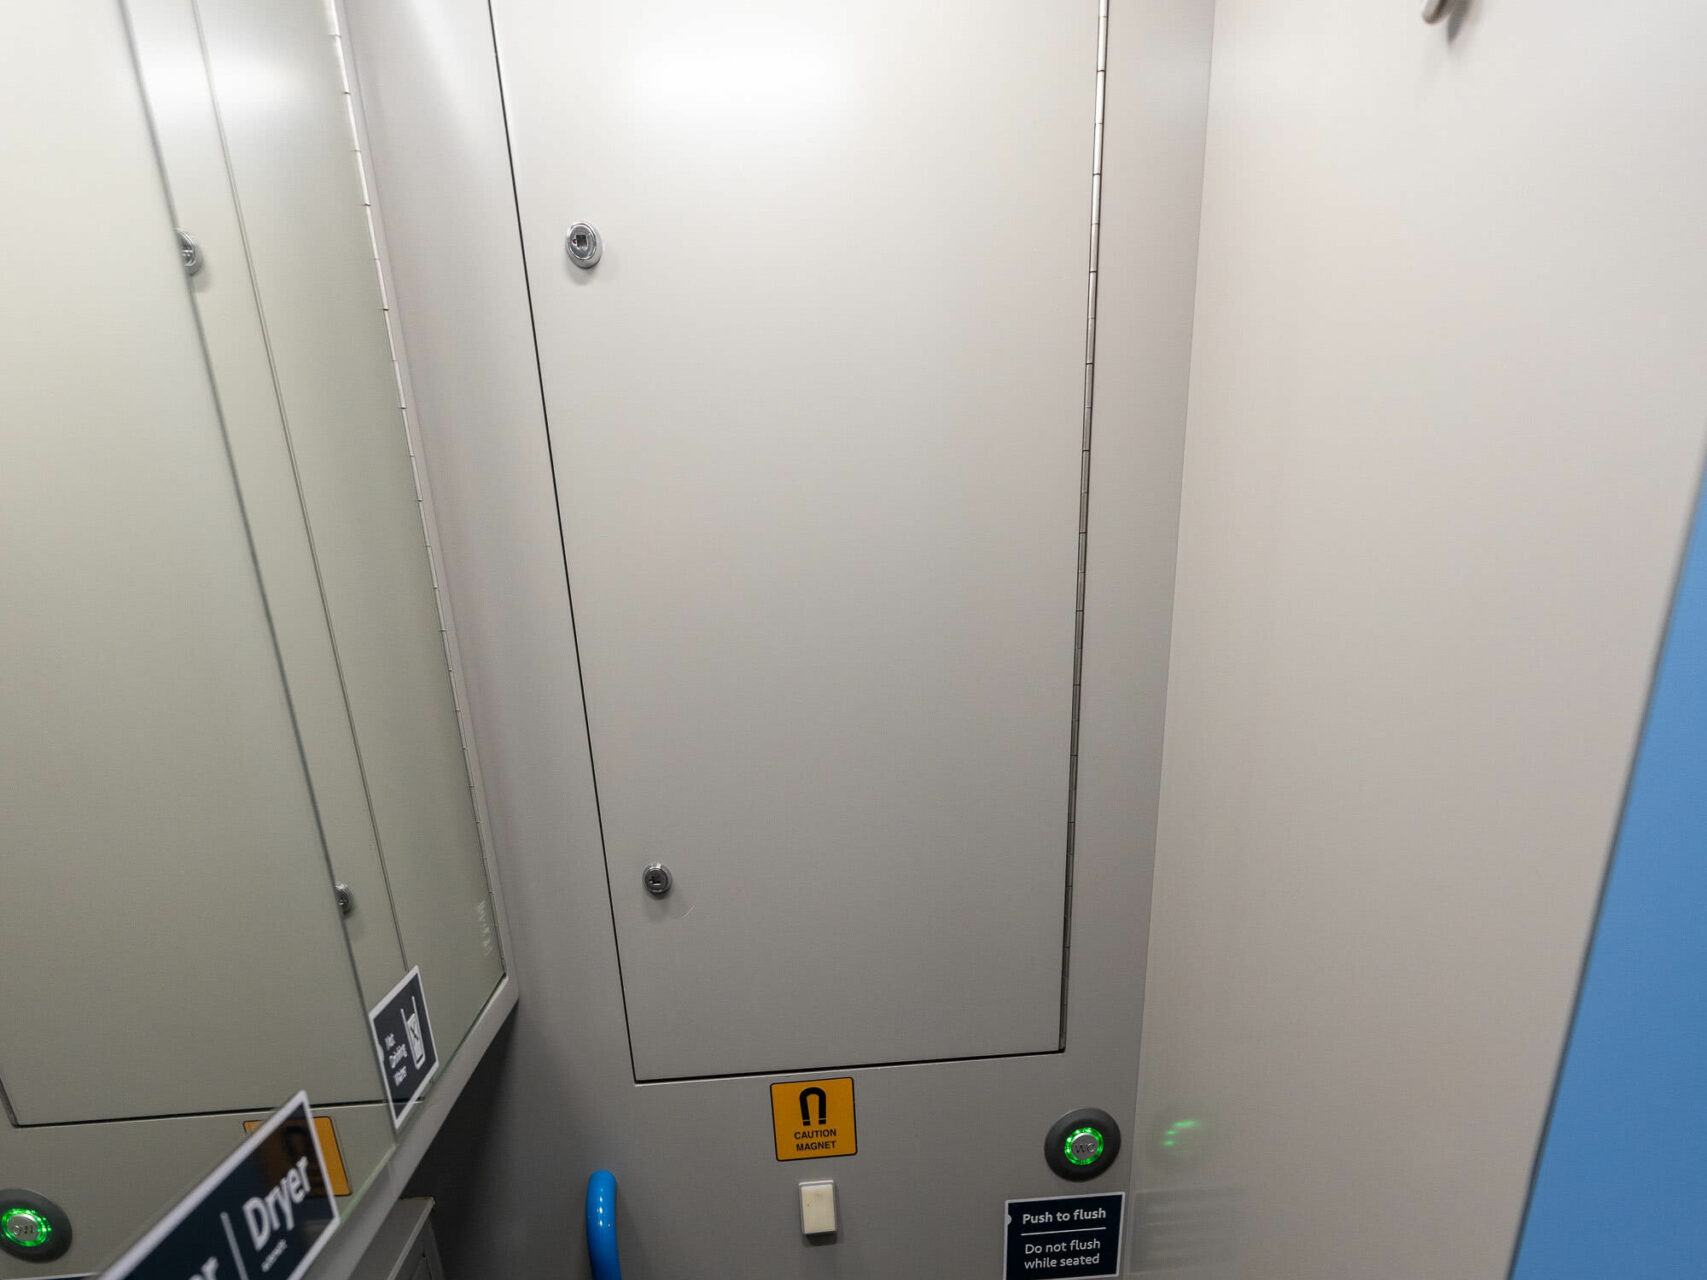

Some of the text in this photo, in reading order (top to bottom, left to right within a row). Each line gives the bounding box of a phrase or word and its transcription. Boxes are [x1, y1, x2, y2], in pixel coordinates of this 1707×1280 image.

[793, 1129, 837, 1140] CAUTION
[796, 1140, 837, 1152] MAGNET
[1074, 1142, 1096, 1154] WC
[243, 1156, 312, 1251] Dryer
[1022, 1207, 1107, 1225] Push to flush
[1025, 1238, 1101, 1254] Do not flush
[1024, 1253, 1100, 1270] while seated
